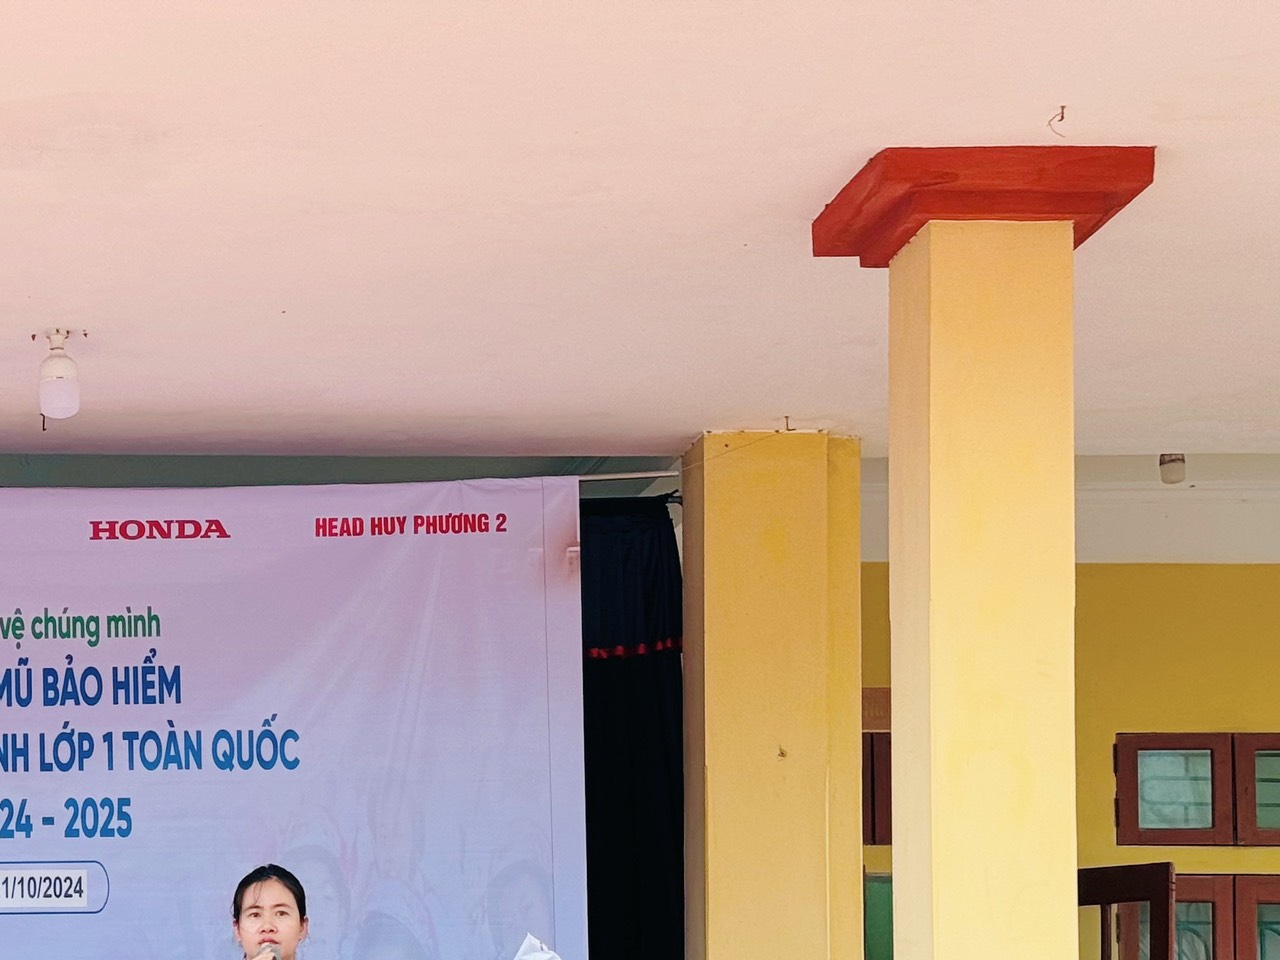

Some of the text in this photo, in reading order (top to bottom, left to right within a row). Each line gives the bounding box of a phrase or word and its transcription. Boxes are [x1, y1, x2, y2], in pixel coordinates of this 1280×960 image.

[89, 519, 231, 541] HONDA
[315, 512, 507, 537] HEAD HUY PHƯƠNG 2
[31, 607, 100, 648] chúng
[106, 605, 161, 638] mình
[42, 653, 103, 707] BẢO
[111, 647, 182, 706] HIỂM
[39, 720, 95, 774] LỚP
[101, 731, 114, 771] 1
[122, 719, 203, 772] TOÀN
[211, 713, 301, 773] QUỐC
[64, 797, 132, 839] 2025
